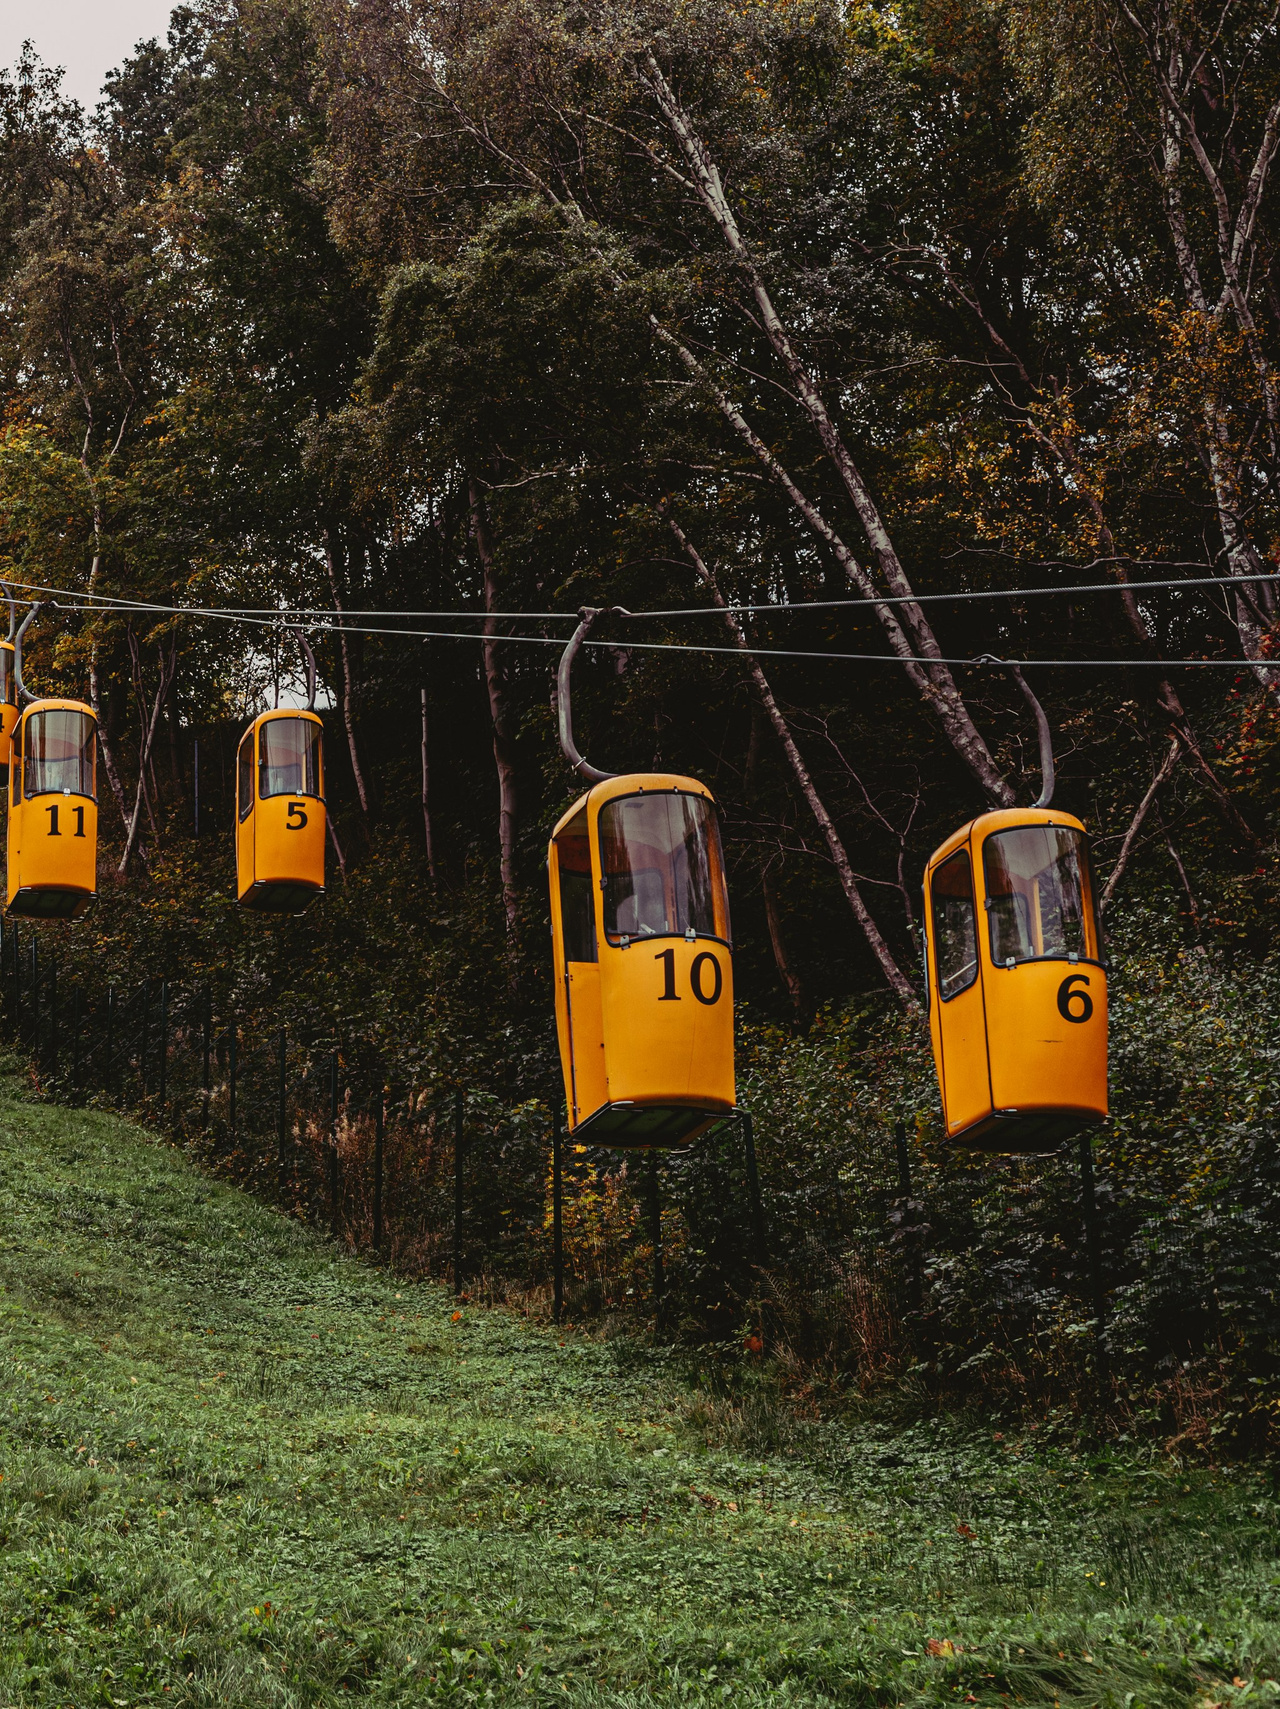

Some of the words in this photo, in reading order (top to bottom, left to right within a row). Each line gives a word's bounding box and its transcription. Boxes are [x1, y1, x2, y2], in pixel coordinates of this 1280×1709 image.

[45, 804, 87, 837] 11
[286, 802, 308, 830] 5
[654, 948, 723, 1005] 10
[1056, 974, 1093, 1023] 6
